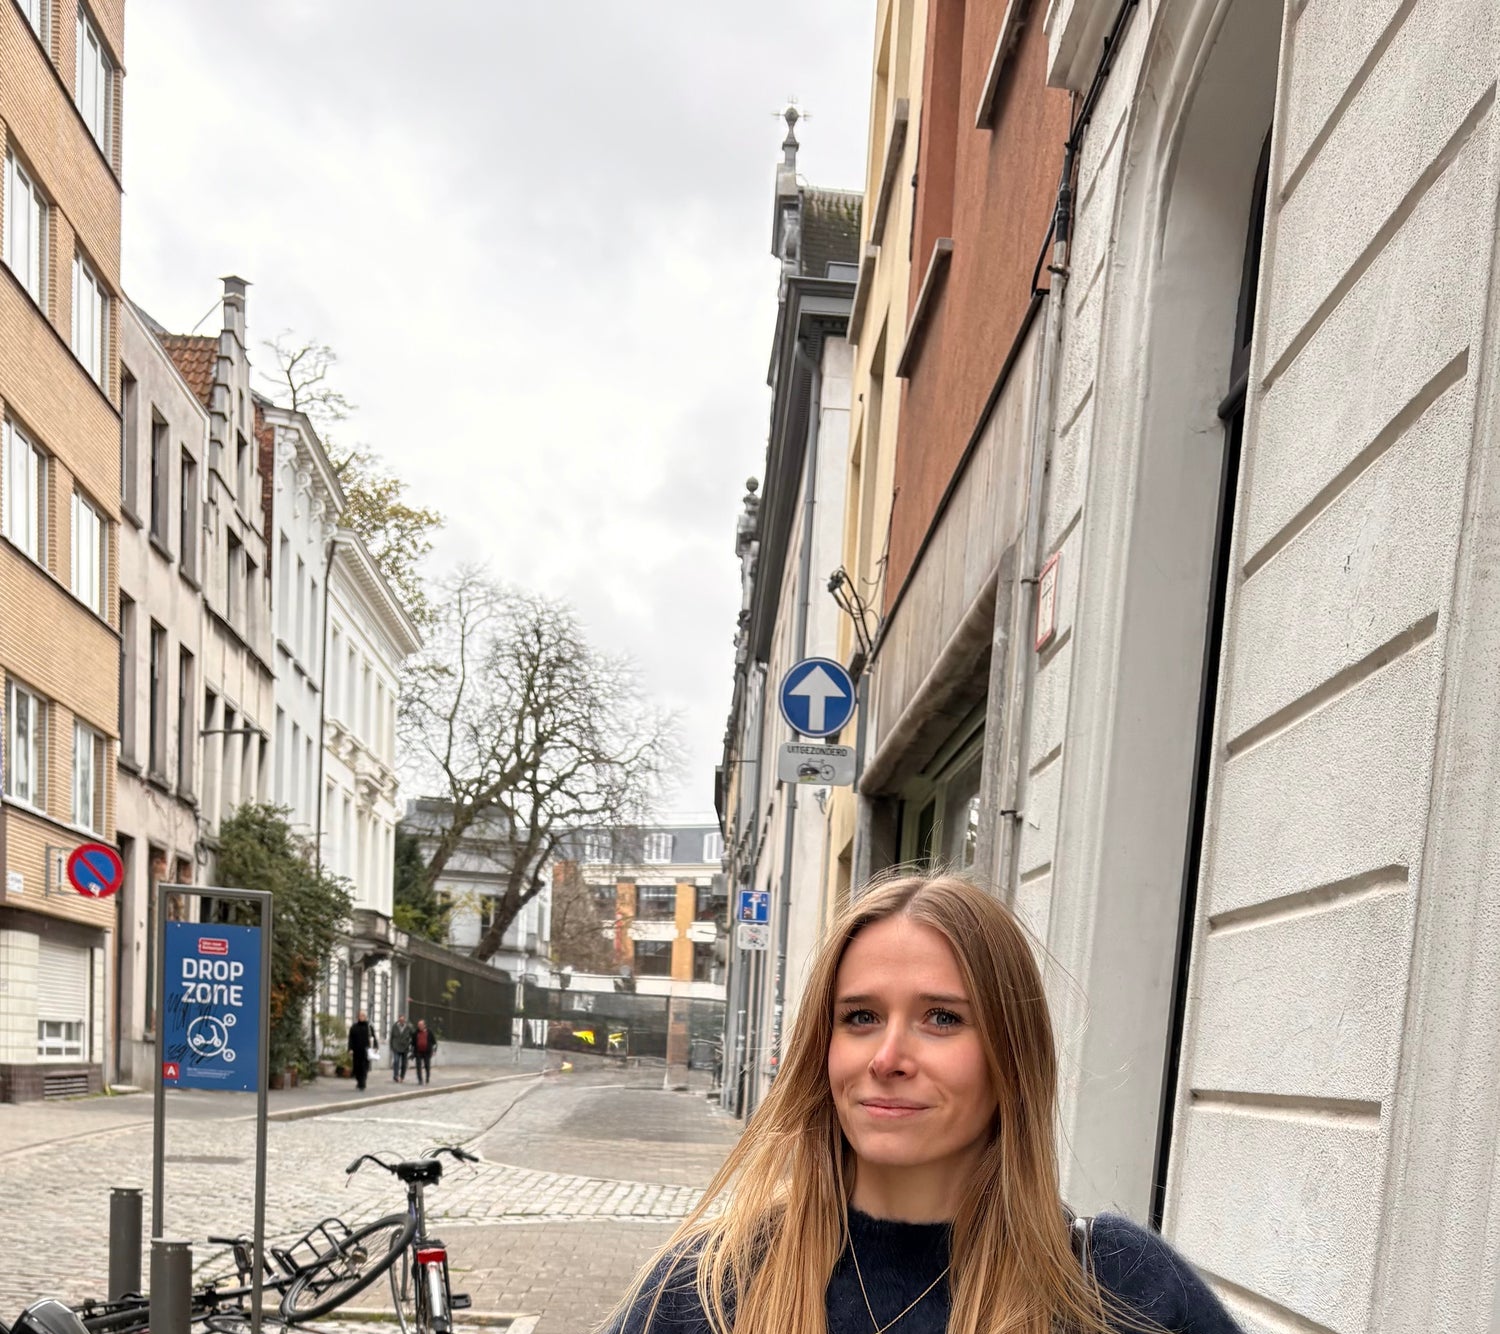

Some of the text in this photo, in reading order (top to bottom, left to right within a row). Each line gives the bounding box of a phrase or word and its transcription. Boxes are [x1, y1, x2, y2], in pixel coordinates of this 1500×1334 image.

[787, 745, 848, 757] UITGEZONDERD
[182, 958, 244, 982] DROP
[166, 1066, 176, 1077] A
